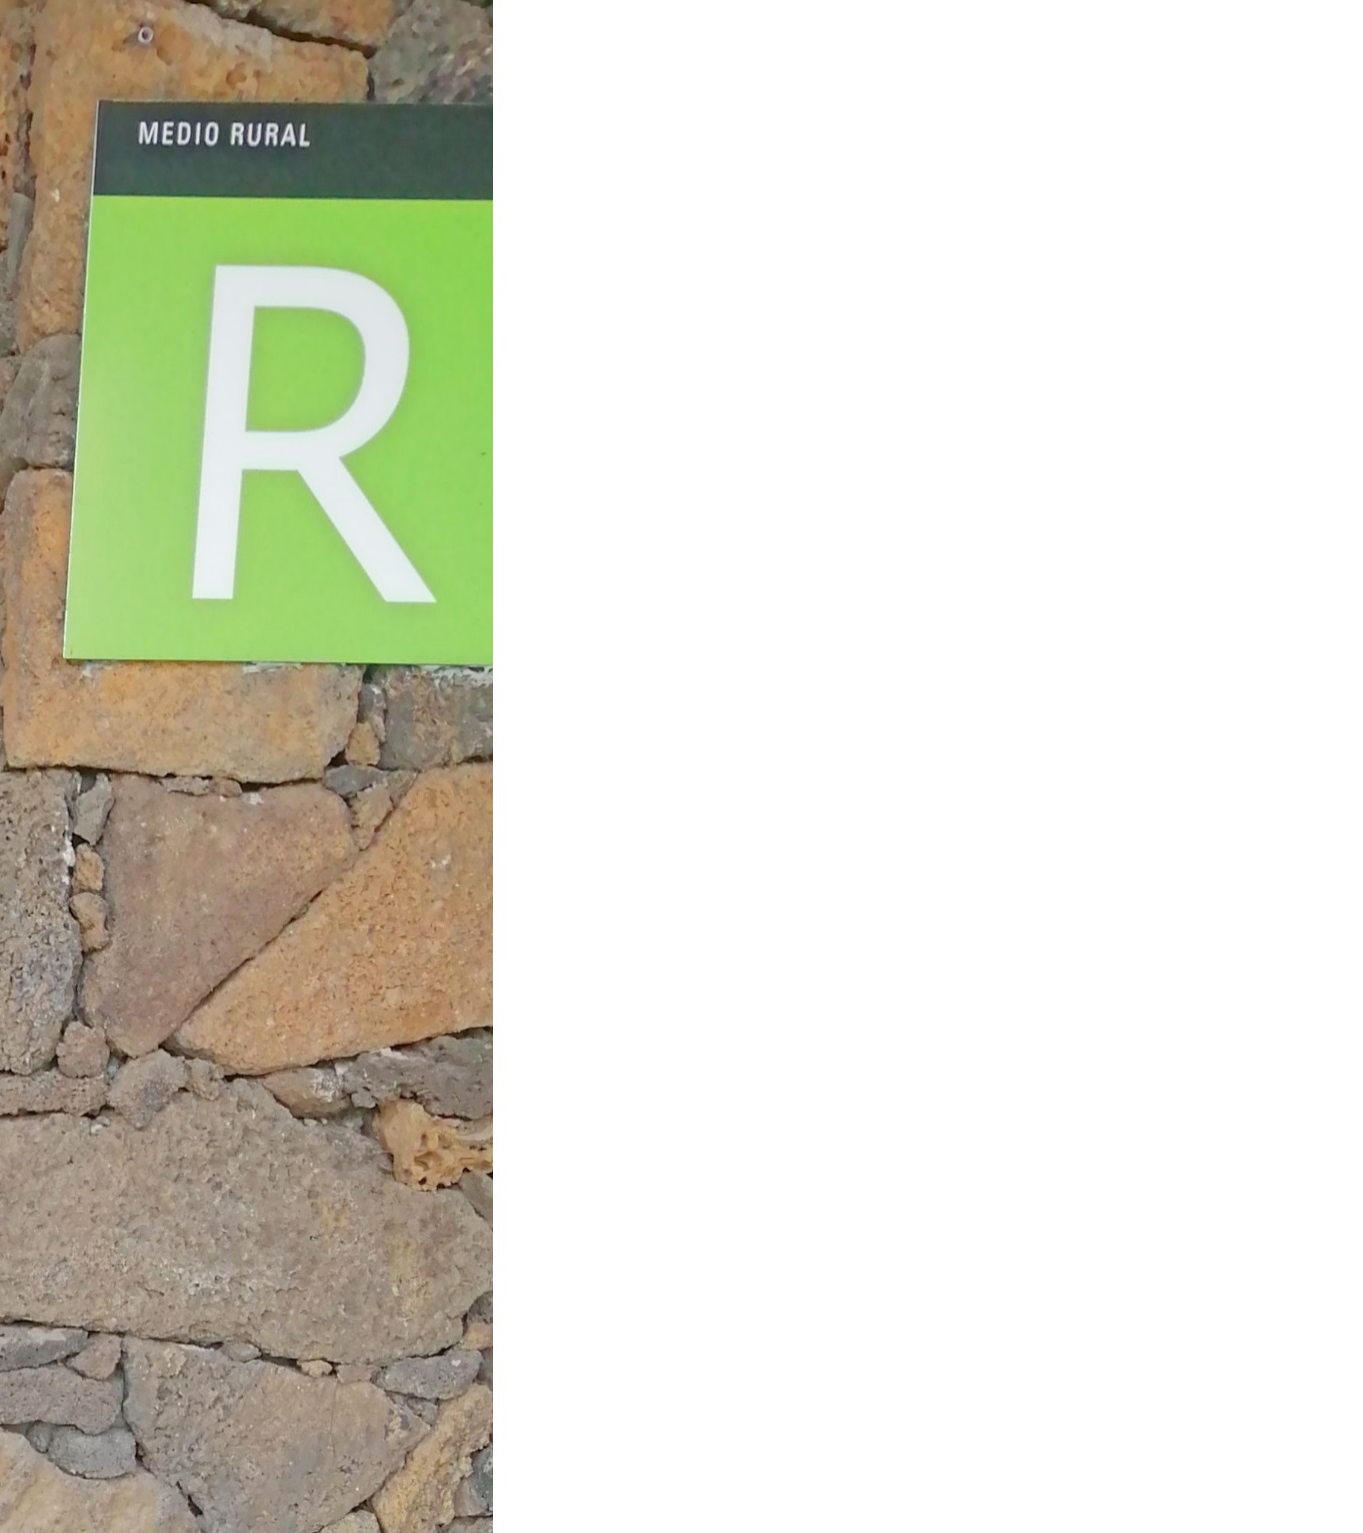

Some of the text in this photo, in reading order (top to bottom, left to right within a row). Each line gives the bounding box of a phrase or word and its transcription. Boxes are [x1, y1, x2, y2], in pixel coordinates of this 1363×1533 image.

[137, 120, 311, 147] MEDIO RURAL
[191, 264, 437, 603] R
